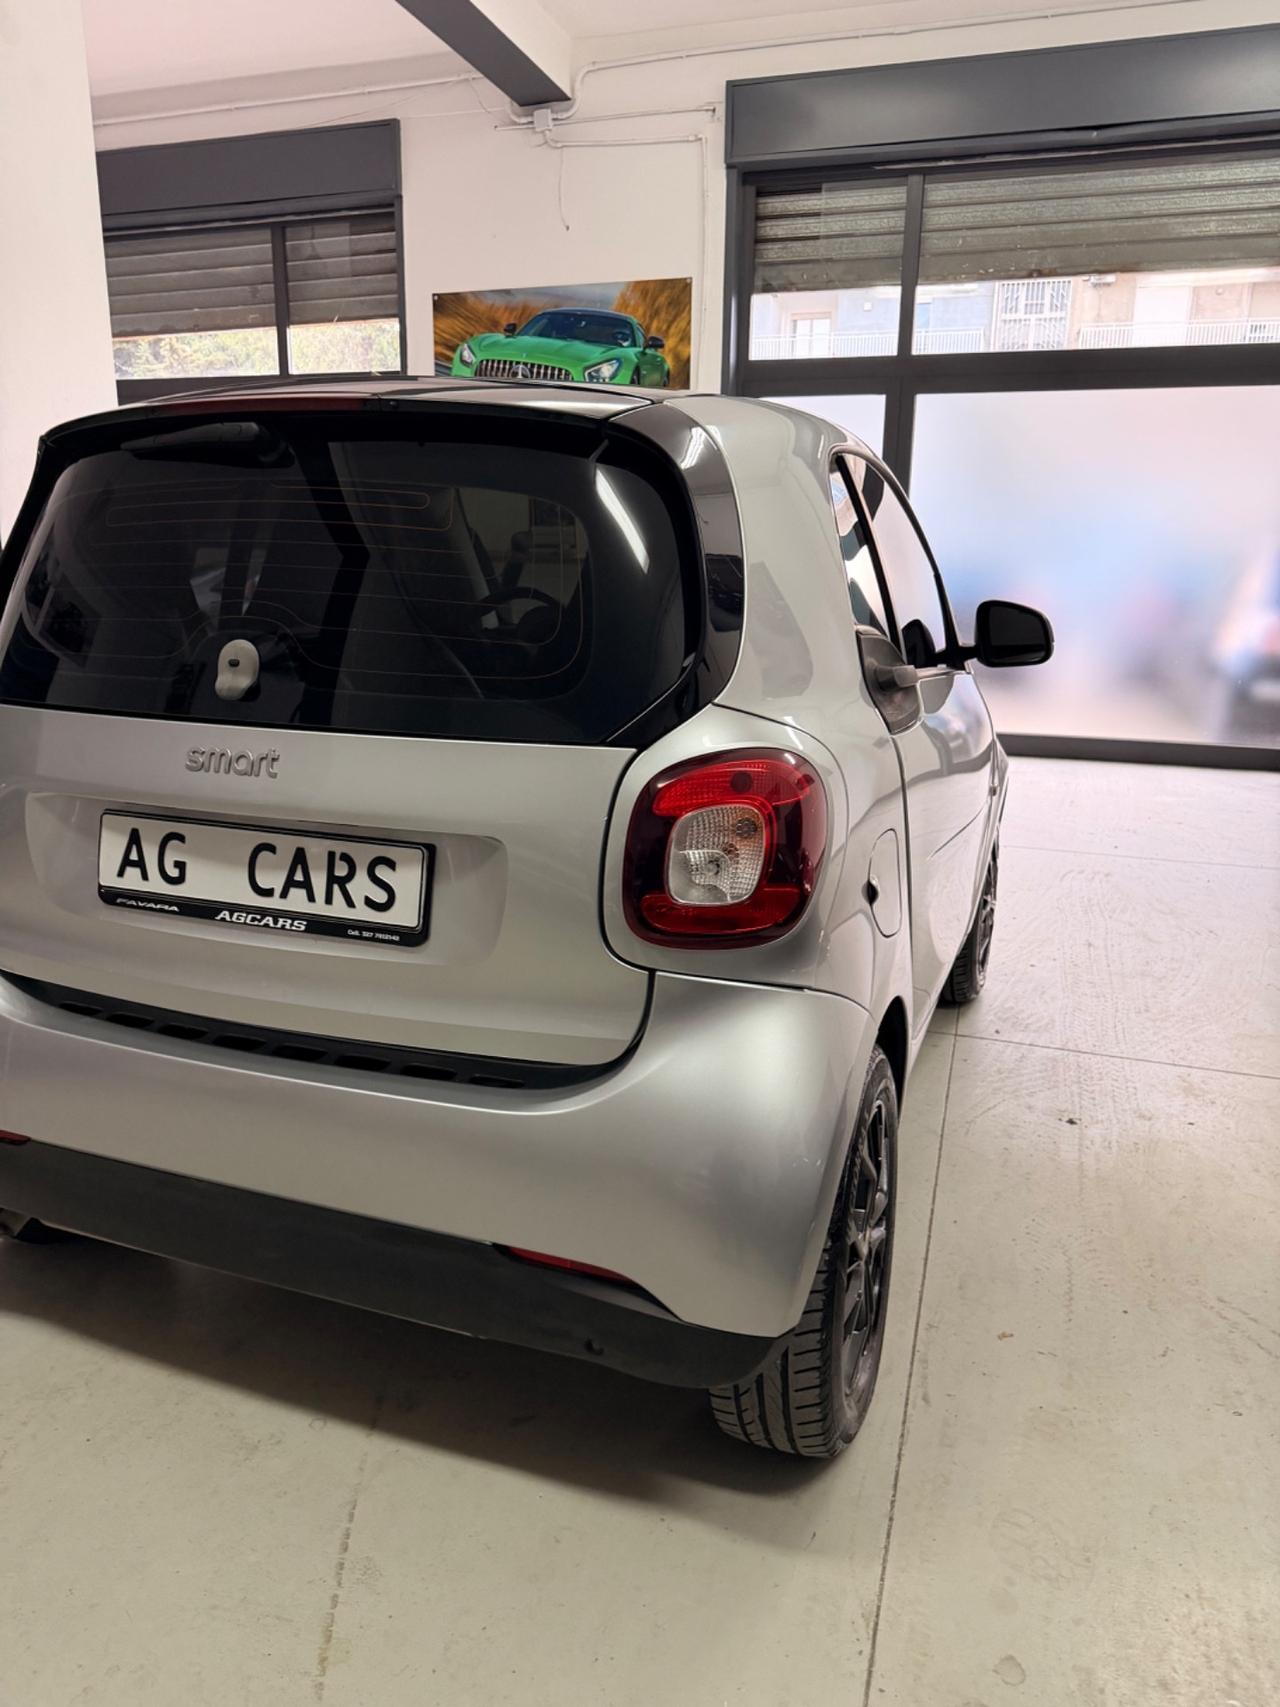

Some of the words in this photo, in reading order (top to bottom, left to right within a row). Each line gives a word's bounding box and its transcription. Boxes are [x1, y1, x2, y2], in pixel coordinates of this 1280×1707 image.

[184, 746, 280, 779] smart
[116, 827, 187, 885] AG
[247, 842, 397, 913] CARS
[214, 910, 307, 932] AGCARS
